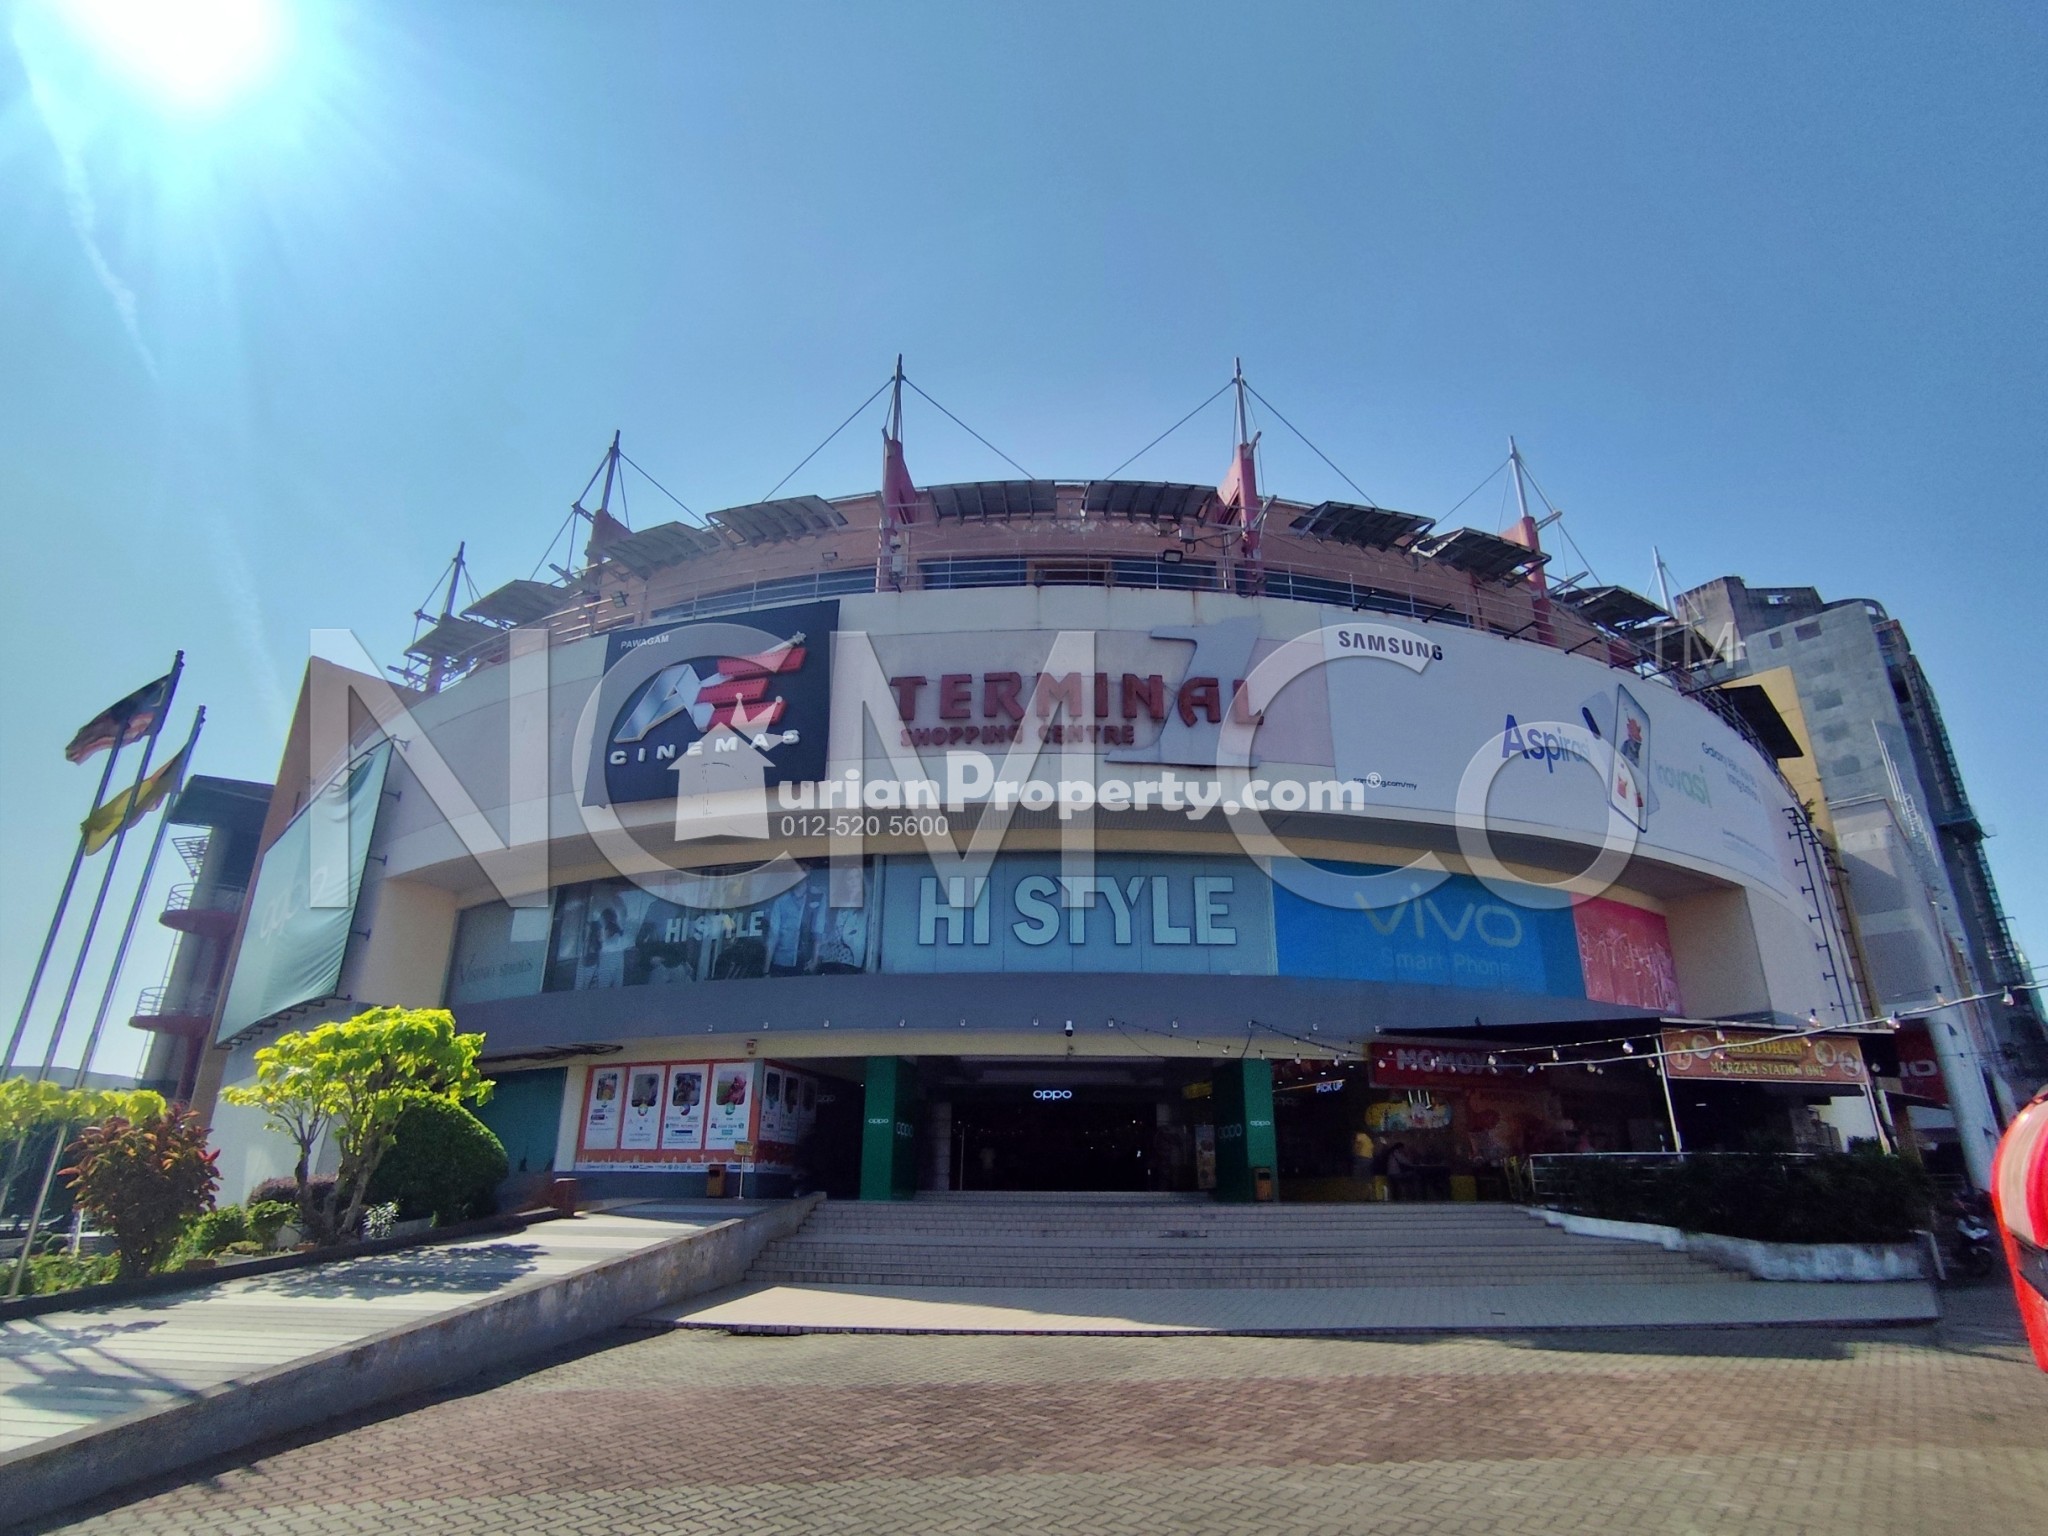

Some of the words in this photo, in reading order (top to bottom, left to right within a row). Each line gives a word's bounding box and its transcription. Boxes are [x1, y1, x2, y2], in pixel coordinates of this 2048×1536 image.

[621, 634, 669, 649] PAWAGAM
[1338, 630, 1443, 661] SAMSUNG
[889, 671, 1264, 727] TERMINAL
[1105, 614, 1262, 768] 1
[610, 729, 800, 765] CINEMAS
[900, 724, 1023, 747] SHOPPING
[1038, 724, 1135, 746] CENTRE
[1502, 714, 1591, 773] Aspirasi
[1353, 776, 1418, 791] samg.com/my
[919, 876, 991, 945] HI
[1012, 875, 1237, 946] STYLE
[665, 918, 689, 943] HI
[1381, 947, 1444, 971] Smart
[1453, 953, 1511, 977] Phone
[1806, 1065, 1827, 1077] ONE
[1033, 1089, 1072, 1101] oppo
[1316, 1082, 1333, 1093] PICK
[1333, 1080, 1343, 1091] UP
[868, 1117, 889, 1125] oppo
